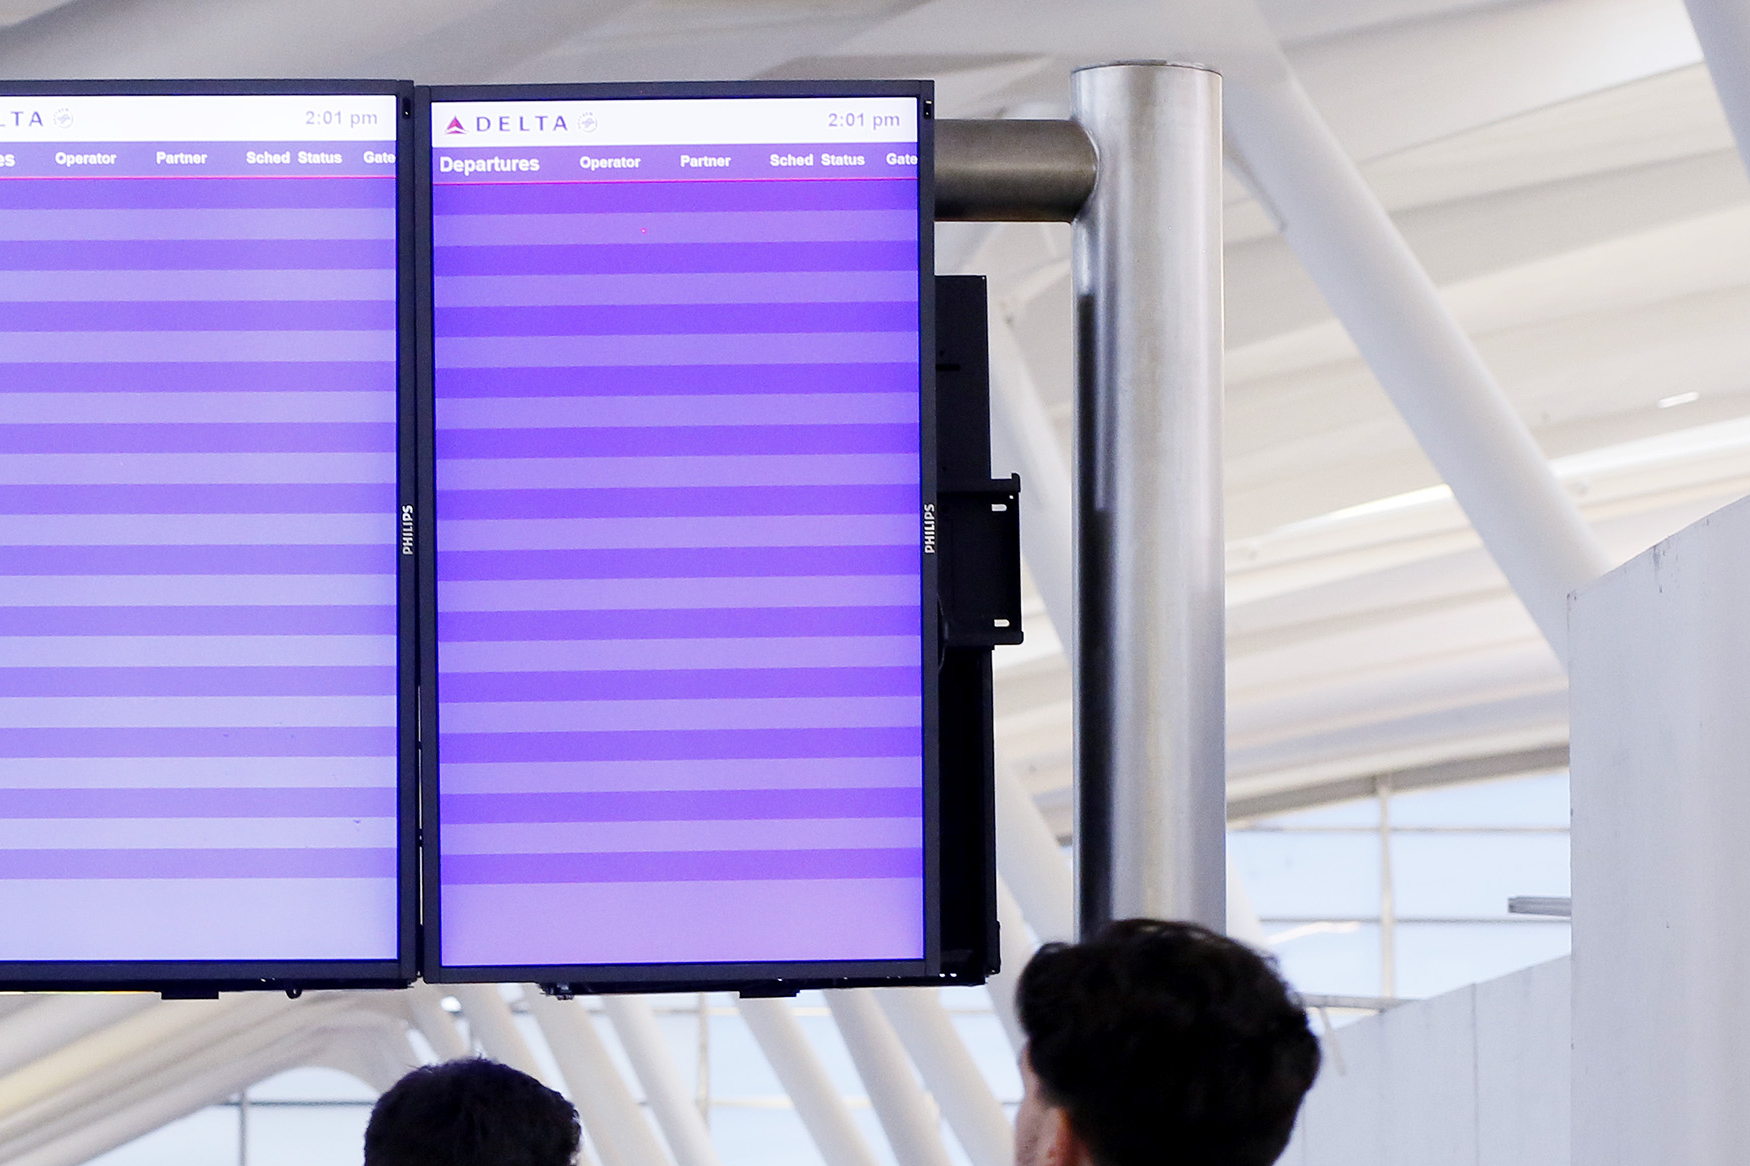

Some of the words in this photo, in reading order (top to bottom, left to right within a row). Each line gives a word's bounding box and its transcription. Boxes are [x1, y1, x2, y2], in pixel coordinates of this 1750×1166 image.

[306, 111, 341, 124] 2:01
[351, 114, 377, 128] pm
[476, 115, 568, 132] DELTA
[829, 113, 863, 127] 2:01
[873, 116, 900, 130] pm
[55, 152, 117, 167] Operator
[157, 152, 207, 164] Partner
[246, 151, 290, 164] Sched
[298, 151, 342, 163] Status
[364, 151, 395, 164] Gate
[440, 156, 541, 175] Departures
[580, 156, 641, 171] Operator
[681, 155, 731, 167] Partner
[770, 154, 813, 166] Sched
[821, 154, 865, 166] Status
[886, 153, 917, 165] Gate
[402, 505, 413, 555] PHILIPS
[924, 504, 935, 554] PHILIPS
